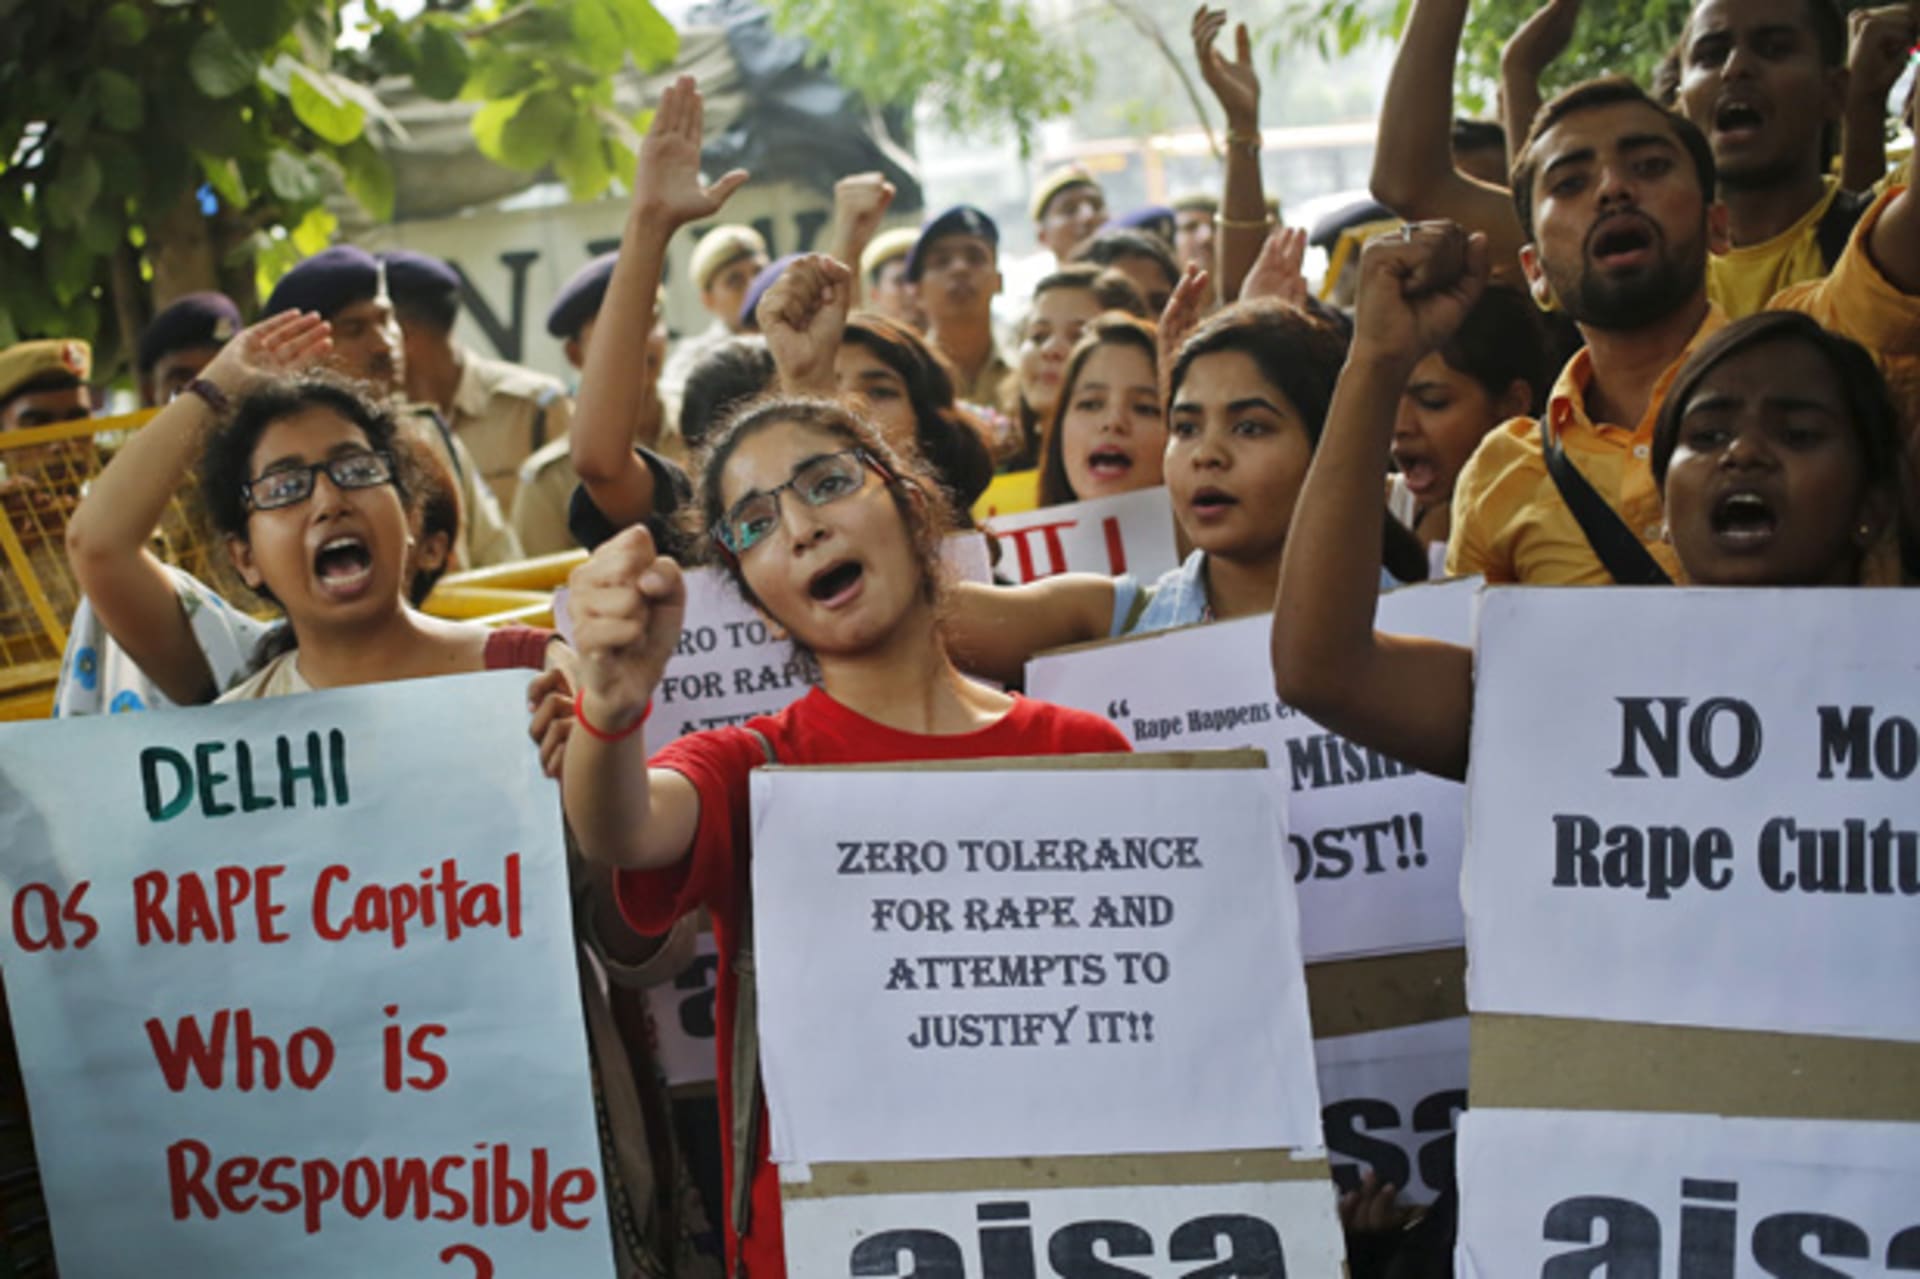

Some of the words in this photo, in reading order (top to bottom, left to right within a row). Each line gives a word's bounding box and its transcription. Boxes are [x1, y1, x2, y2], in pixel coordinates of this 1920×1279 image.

[662, 672, 726, 703] FOR
[1187, 702, 1271, 732] Happens
[140, 729, 349, 822] DELHI
[1607, 697, 1762, 778] NO
[1817, 706, 1920, 780] Mo
[836, 842, 947, 875] ZERO
[958, 837, 1203, 873] TOLERANCE
[1552, 814, 1733, 900] Rape
[133, 865, 290, 946] RAPE
[312, 853, 522, 948] Capital
[872, 898, 953, 932] FOR
[964, 898, 1080, 930] RAPE
[1089, 895, 1174, 929] AND
[884, 954, 1107, 990] ATTEMPTS
[1114, 952, 1169, 984] TO
[144, 1007, 334, 1092] Who
[383, 1005, 447, 1092] is
[908, 1005, 1079, 1049] JUSTIFY
[1087, 1011, 1154, 1044] IT!!
[166, 1139, 597, 1234] Responsible
[1540, 1178, 1920, 1279] ais
